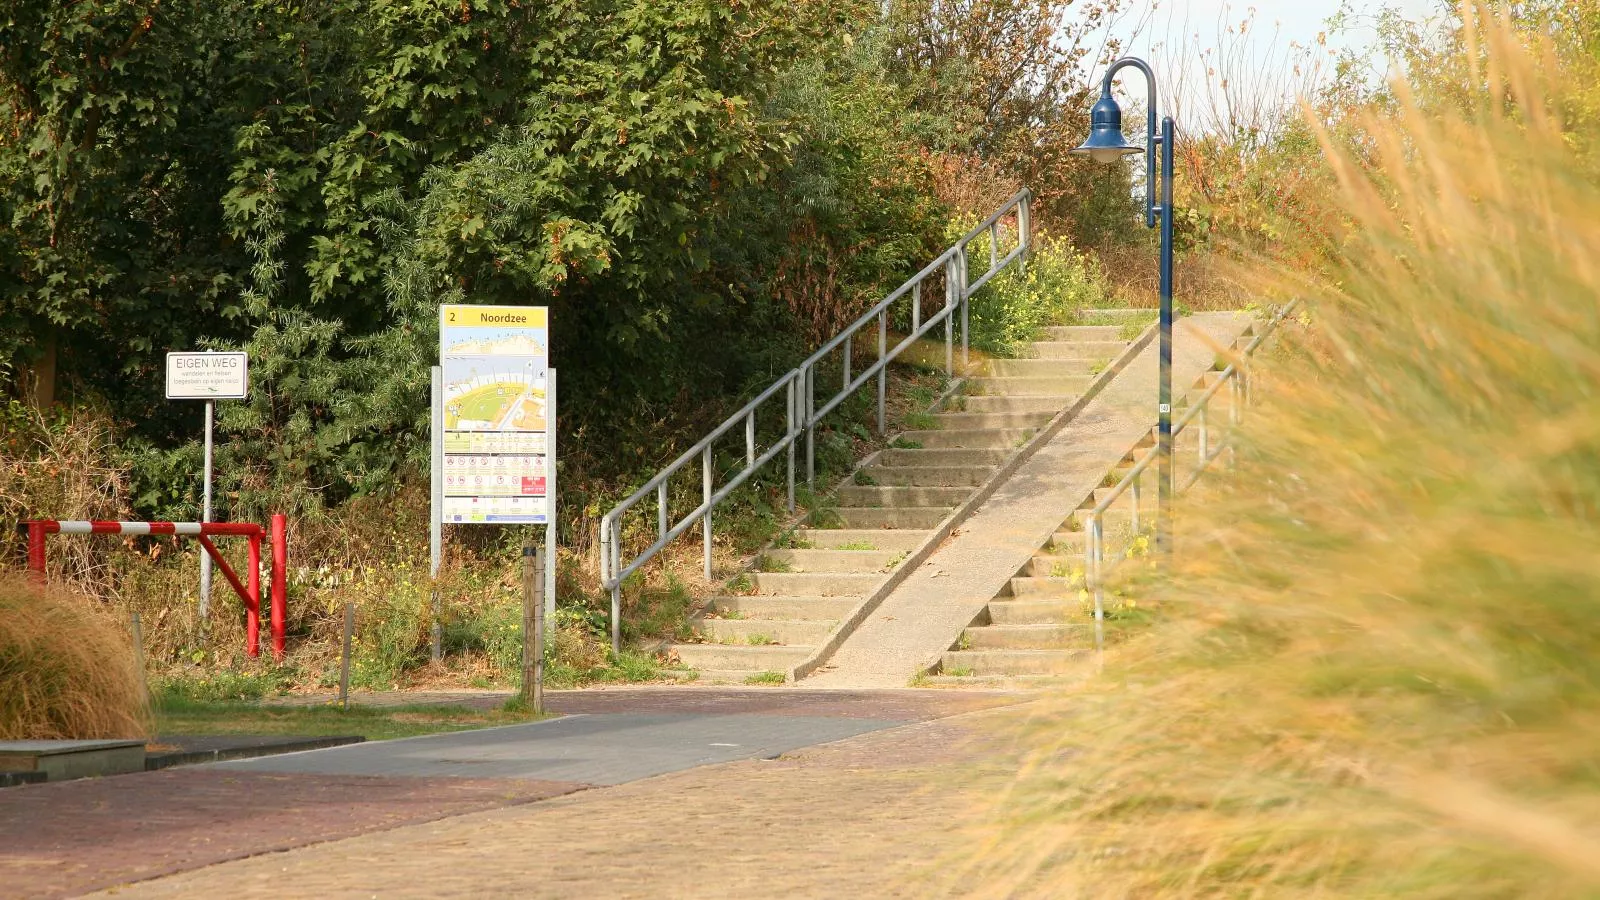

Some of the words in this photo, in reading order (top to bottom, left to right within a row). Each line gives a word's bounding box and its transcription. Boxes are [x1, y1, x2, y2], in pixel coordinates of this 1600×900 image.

[449, 312, 456, 322] 2
[480, 312, 527, 323] Noordzee
[176, 358, 208, 368] EIGEN
[212, 358, 236, 368] WEG
